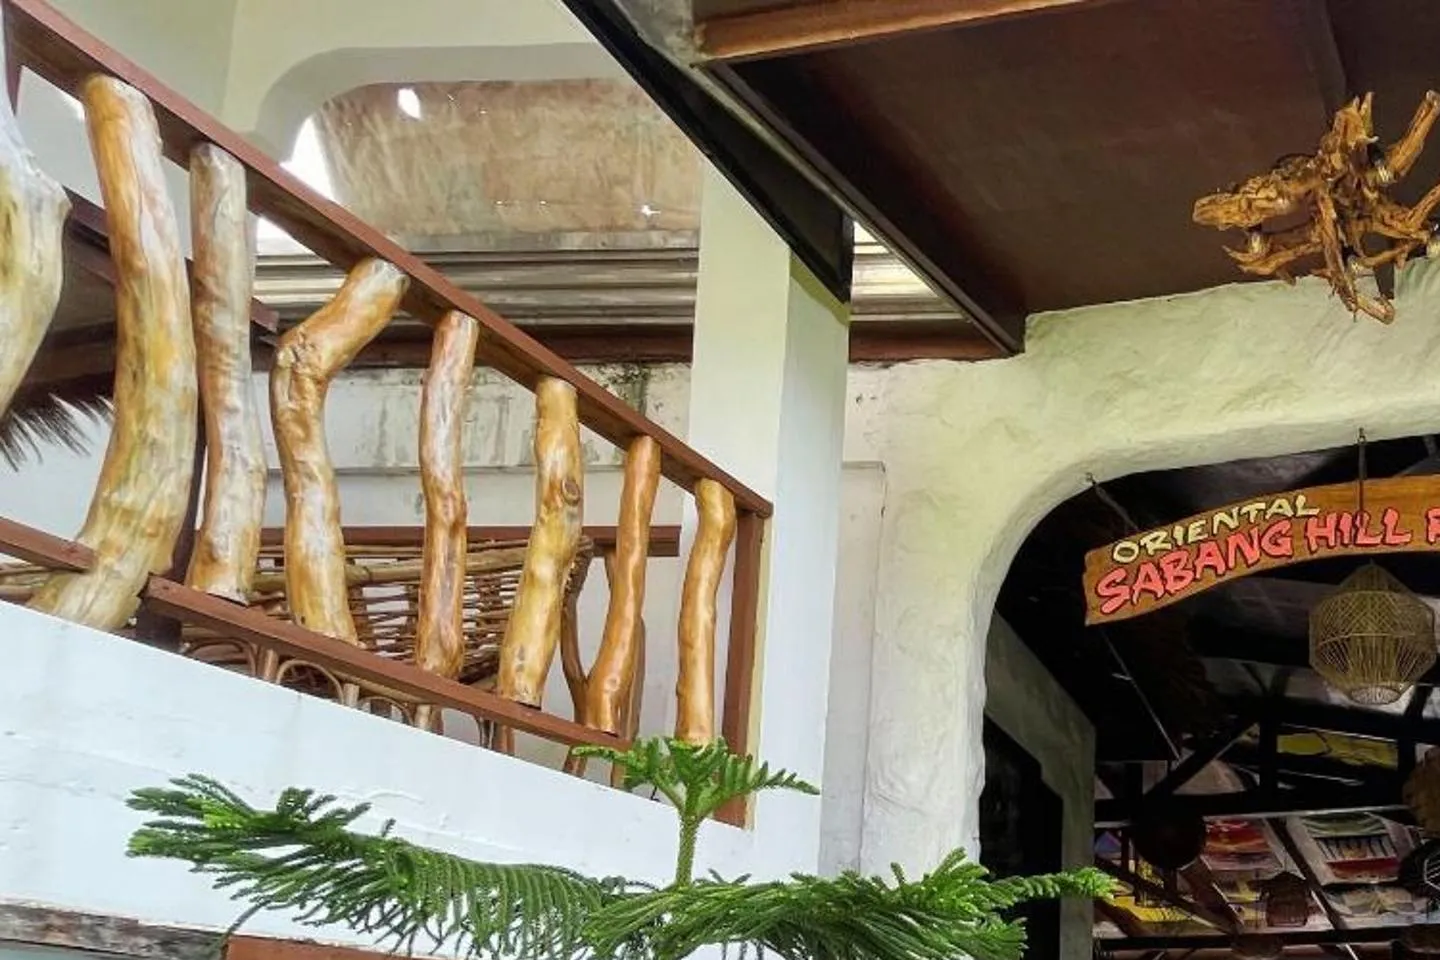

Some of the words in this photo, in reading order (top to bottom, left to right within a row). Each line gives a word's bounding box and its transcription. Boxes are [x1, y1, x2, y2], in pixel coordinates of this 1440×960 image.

[1095, 518, 1294, 615] SABANG
[1304, 508, 1411, 552] HILL
[1112, 495, 1320, 563] ORIENTAL
